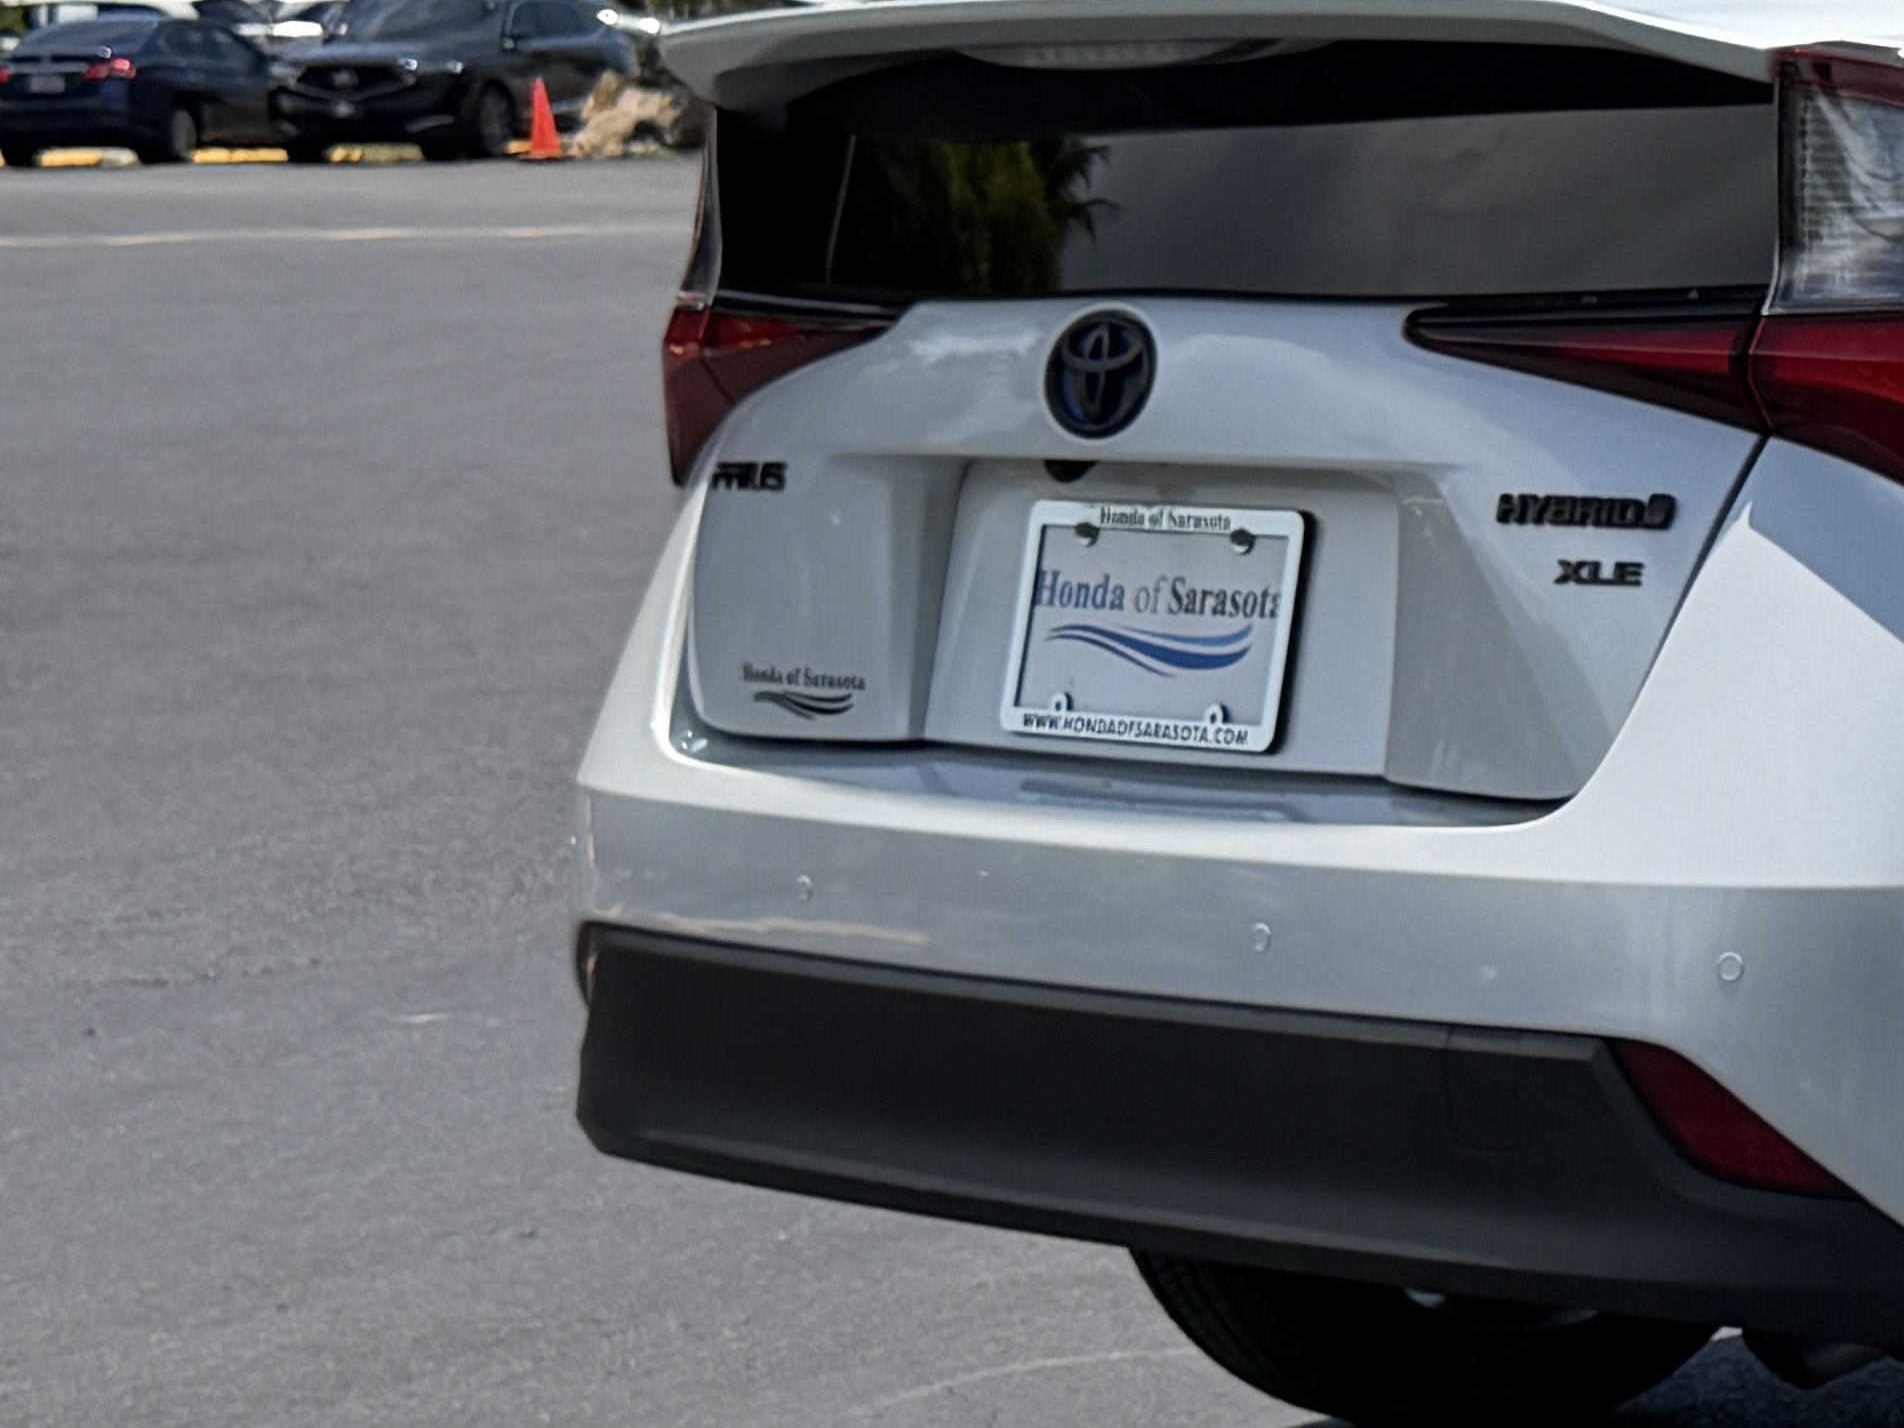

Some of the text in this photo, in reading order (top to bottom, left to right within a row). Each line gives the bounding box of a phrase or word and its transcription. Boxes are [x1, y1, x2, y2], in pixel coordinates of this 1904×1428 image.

[1100, 506, 1145, 525] Honda
[1167, 511, 1231, 530] Sarasota
[1496, 493, 1648, 529] HYBRID
[1553, 558, 1645, 587] XLE
[1035, 570, 1125, 611] Honda
[1134, 577, 1168, 613] of
